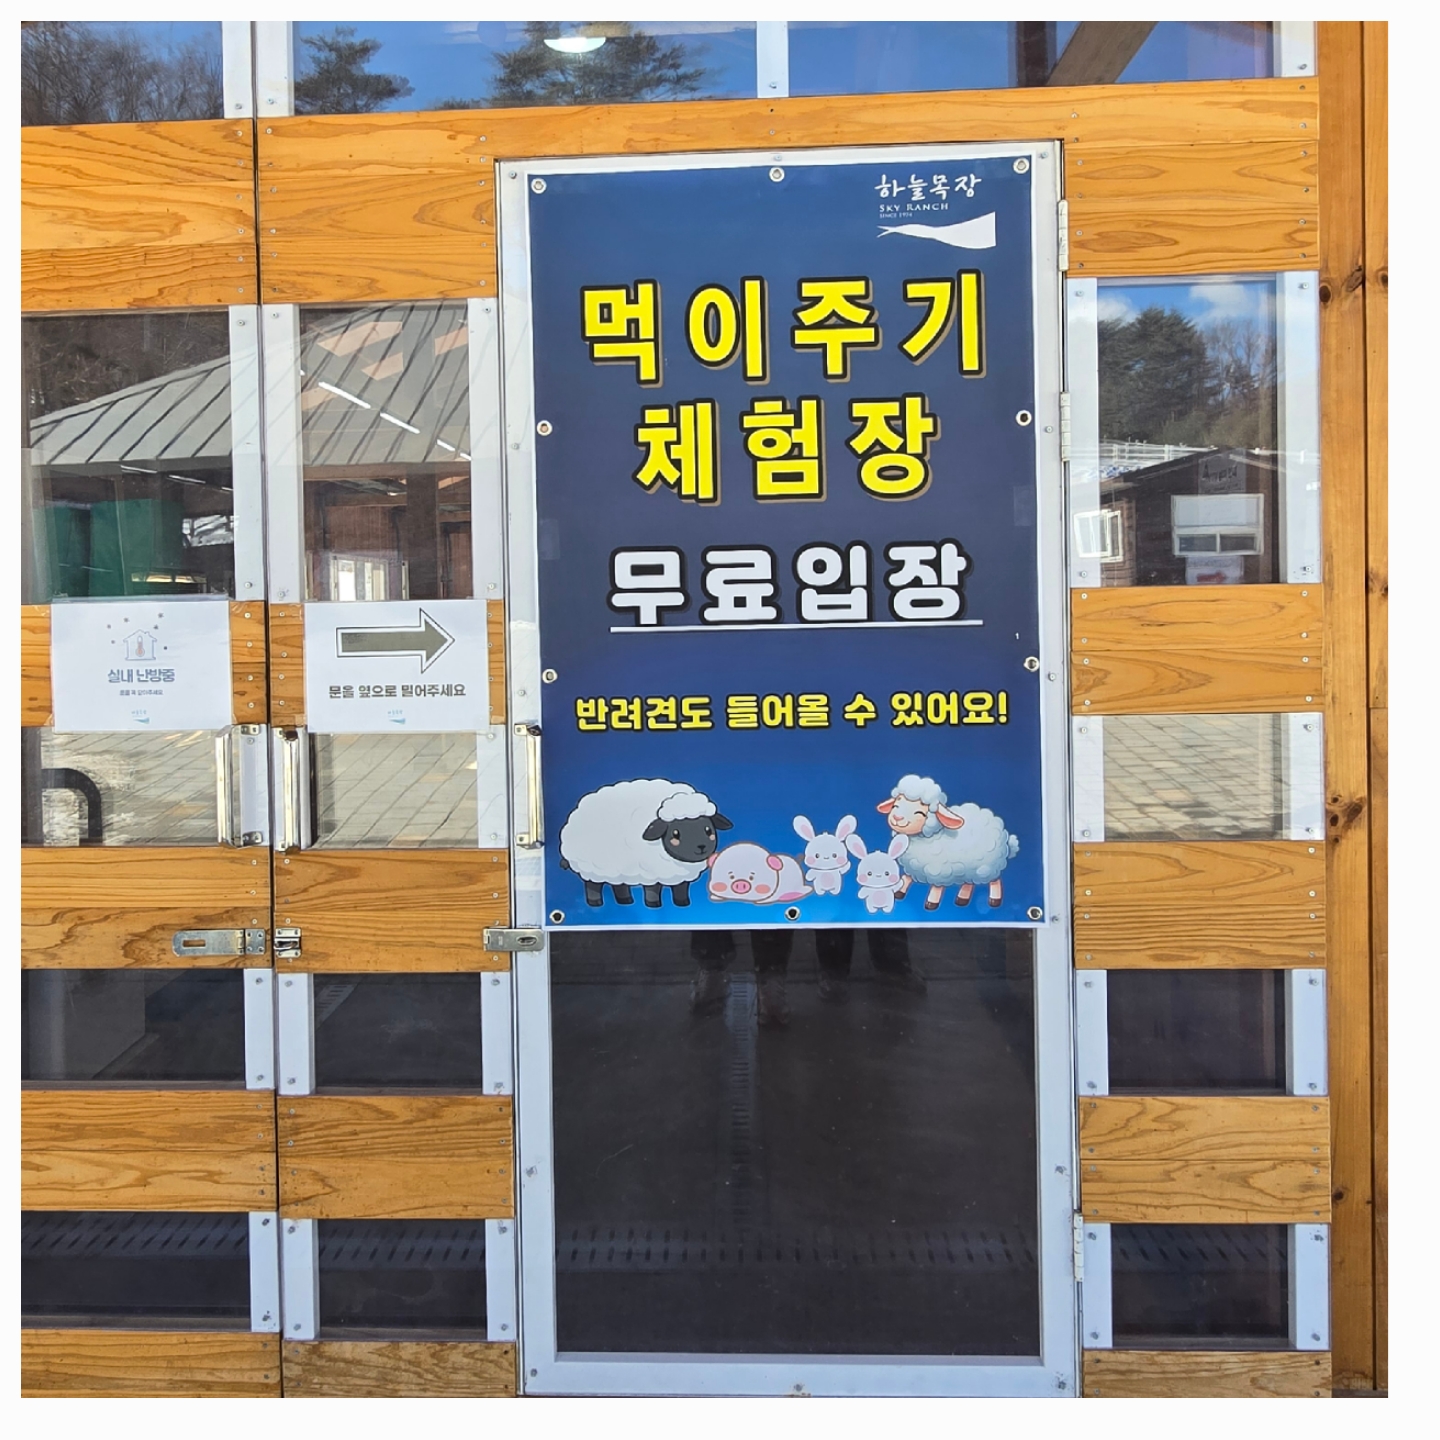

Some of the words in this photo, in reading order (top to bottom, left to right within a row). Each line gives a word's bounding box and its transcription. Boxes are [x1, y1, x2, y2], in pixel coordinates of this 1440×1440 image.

[874, 173, 982, 201] 하늘목장
[879, 204, 901, 212] SKY
[906, 202, 948, 211] RANCH
[582, 271, 985, 384] 먹이주기
[635, 396, 940, 502] 체험장
[609, 540, 966, 626] 무료입장
[108, 668, 134, 683] 실내
[136, 668, 176, 682] 난방중
[329, 685, 354, 699] 문을
[358, 684, 397, 698] 옆으로
[401, 684, 466, 698] 밀어주세요
[575, 695, 713, 732] 반려견도
[726, 693, 830, 729] 들어올
[843, 692, 878, 728] 수
[890, 690, 1008, 727] 있어요!
